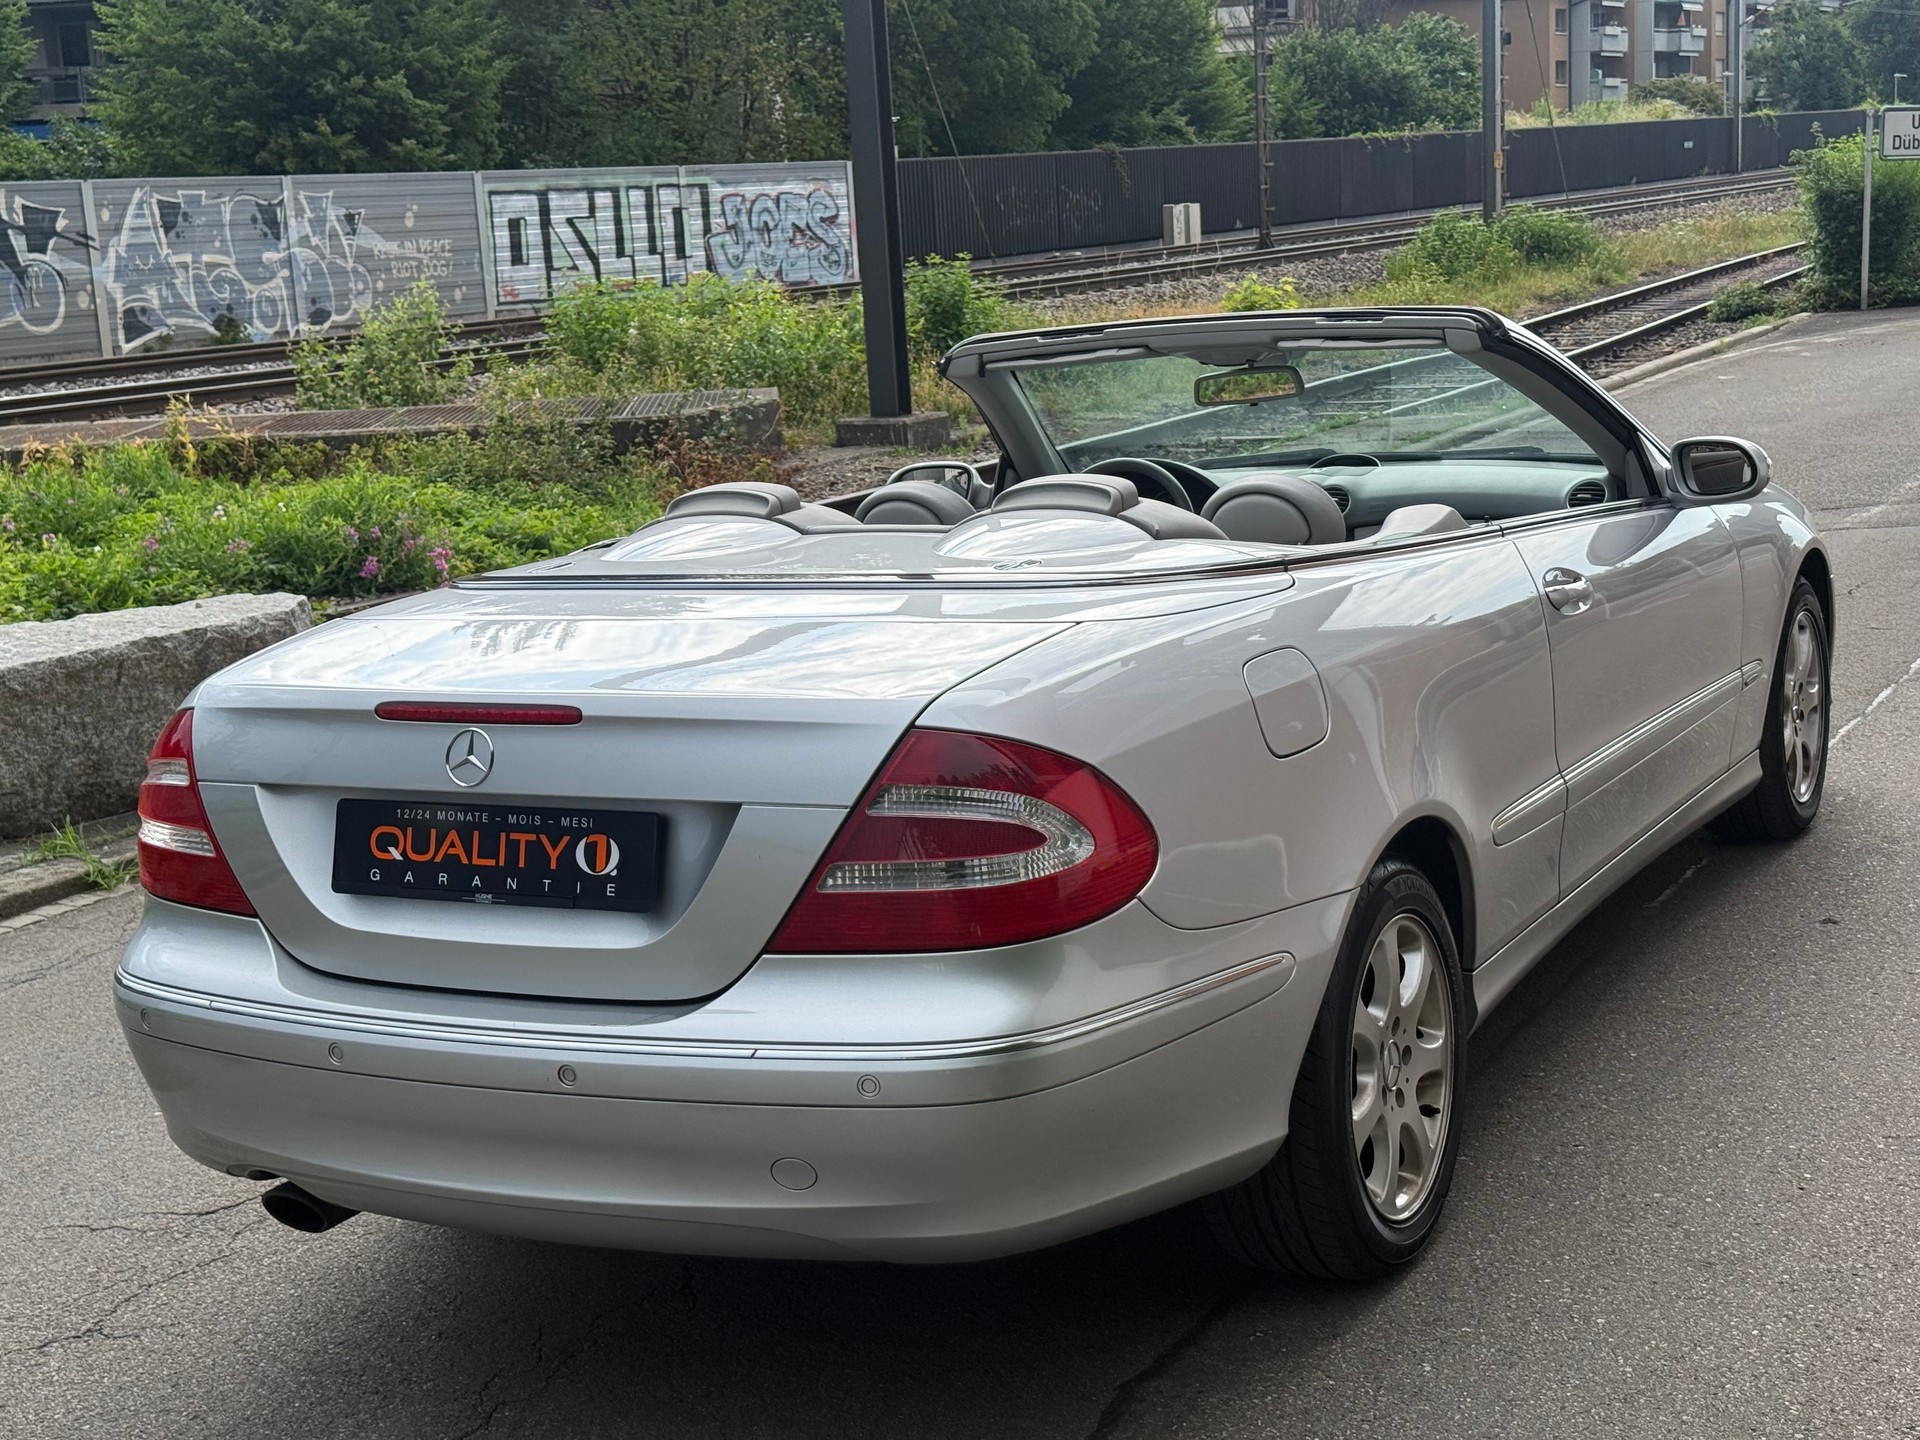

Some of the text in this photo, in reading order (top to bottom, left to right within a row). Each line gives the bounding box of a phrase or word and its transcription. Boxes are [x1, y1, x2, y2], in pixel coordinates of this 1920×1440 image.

[1892, 133, 1920, 150] Düb
[419, 239, 452, 256] PEACE
[391, 261, 418, 278] RIOT
[396, 808, 430, 820] 12/24
[437, 810, 489, 823] MONATE
[508, 814, 541, 825] MOIS
[561, 816, 593, 828] MESI
[370, 825, 571, 870] QUALITY
[370, 868, 616, 896] GARANTIE
